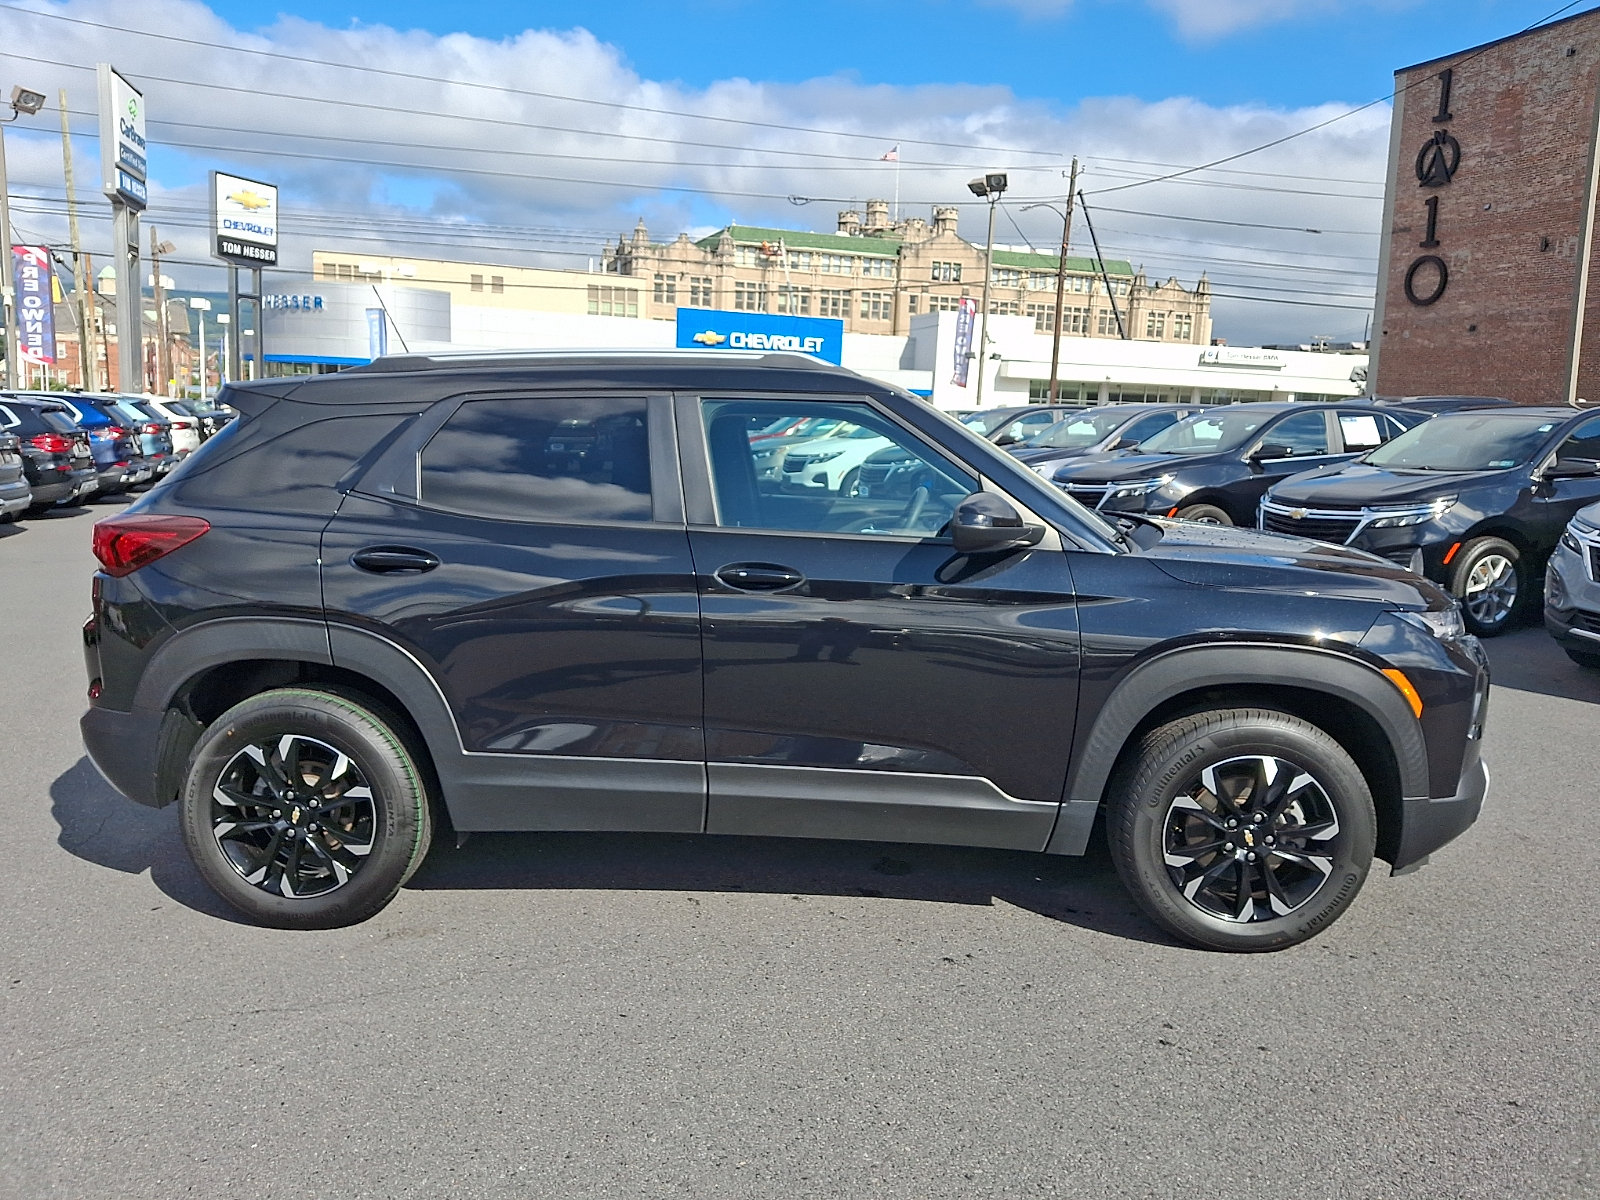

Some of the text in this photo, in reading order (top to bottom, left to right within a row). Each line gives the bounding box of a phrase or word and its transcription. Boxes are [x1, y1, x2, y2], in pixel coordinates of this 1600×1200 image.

[223, 218, 274, 236] CHEVROLET
[222, 241, 276, 261] TOM HESSER
[729, 331, 824, 353] CHEVROLET
[1149, 750, 1198, 808] Continental
